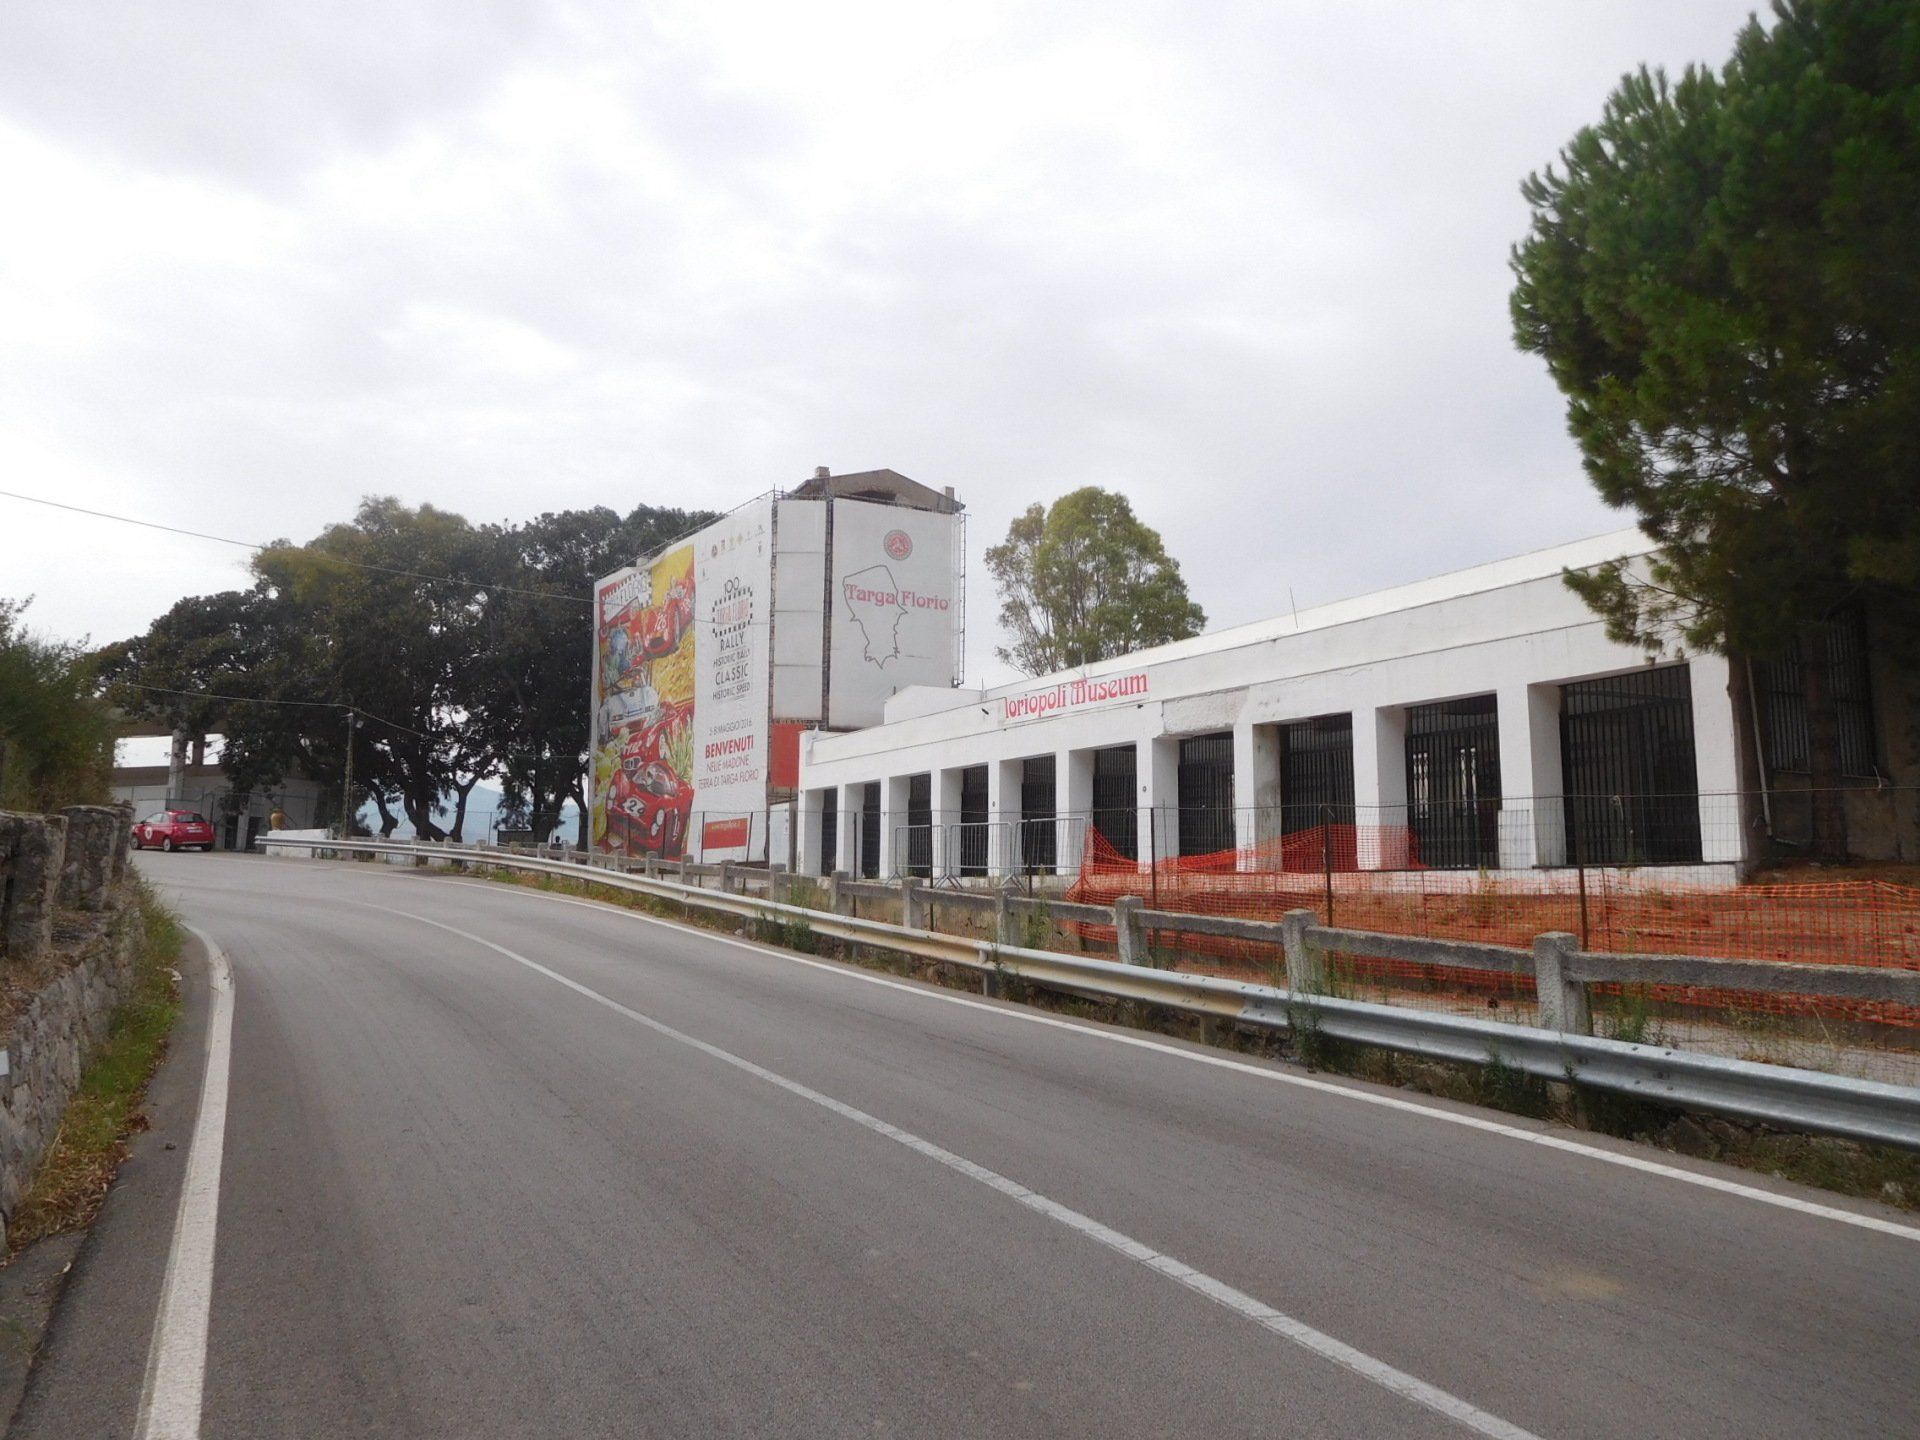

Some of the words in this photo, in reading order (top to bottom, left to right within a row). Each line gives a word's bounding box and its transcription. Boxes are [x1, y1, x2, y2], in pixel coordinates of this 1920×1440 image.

[724, 576, 740, 595] 100
[845, 583, 897, 607] Targa
[901, 590, 949, 611] Florio
[720, 631, 745, 652] RALLY
[715, 662, 749, 686] CLASSIC
[712, 686, 735, 701] HISTORIC
[1071, 672, 1149, 706] Museum
[705, 734, 754, 759] BENVENUTI
[721, 773, 739, 786] TARGA
[740, 768, 759, 783] FLORIO
